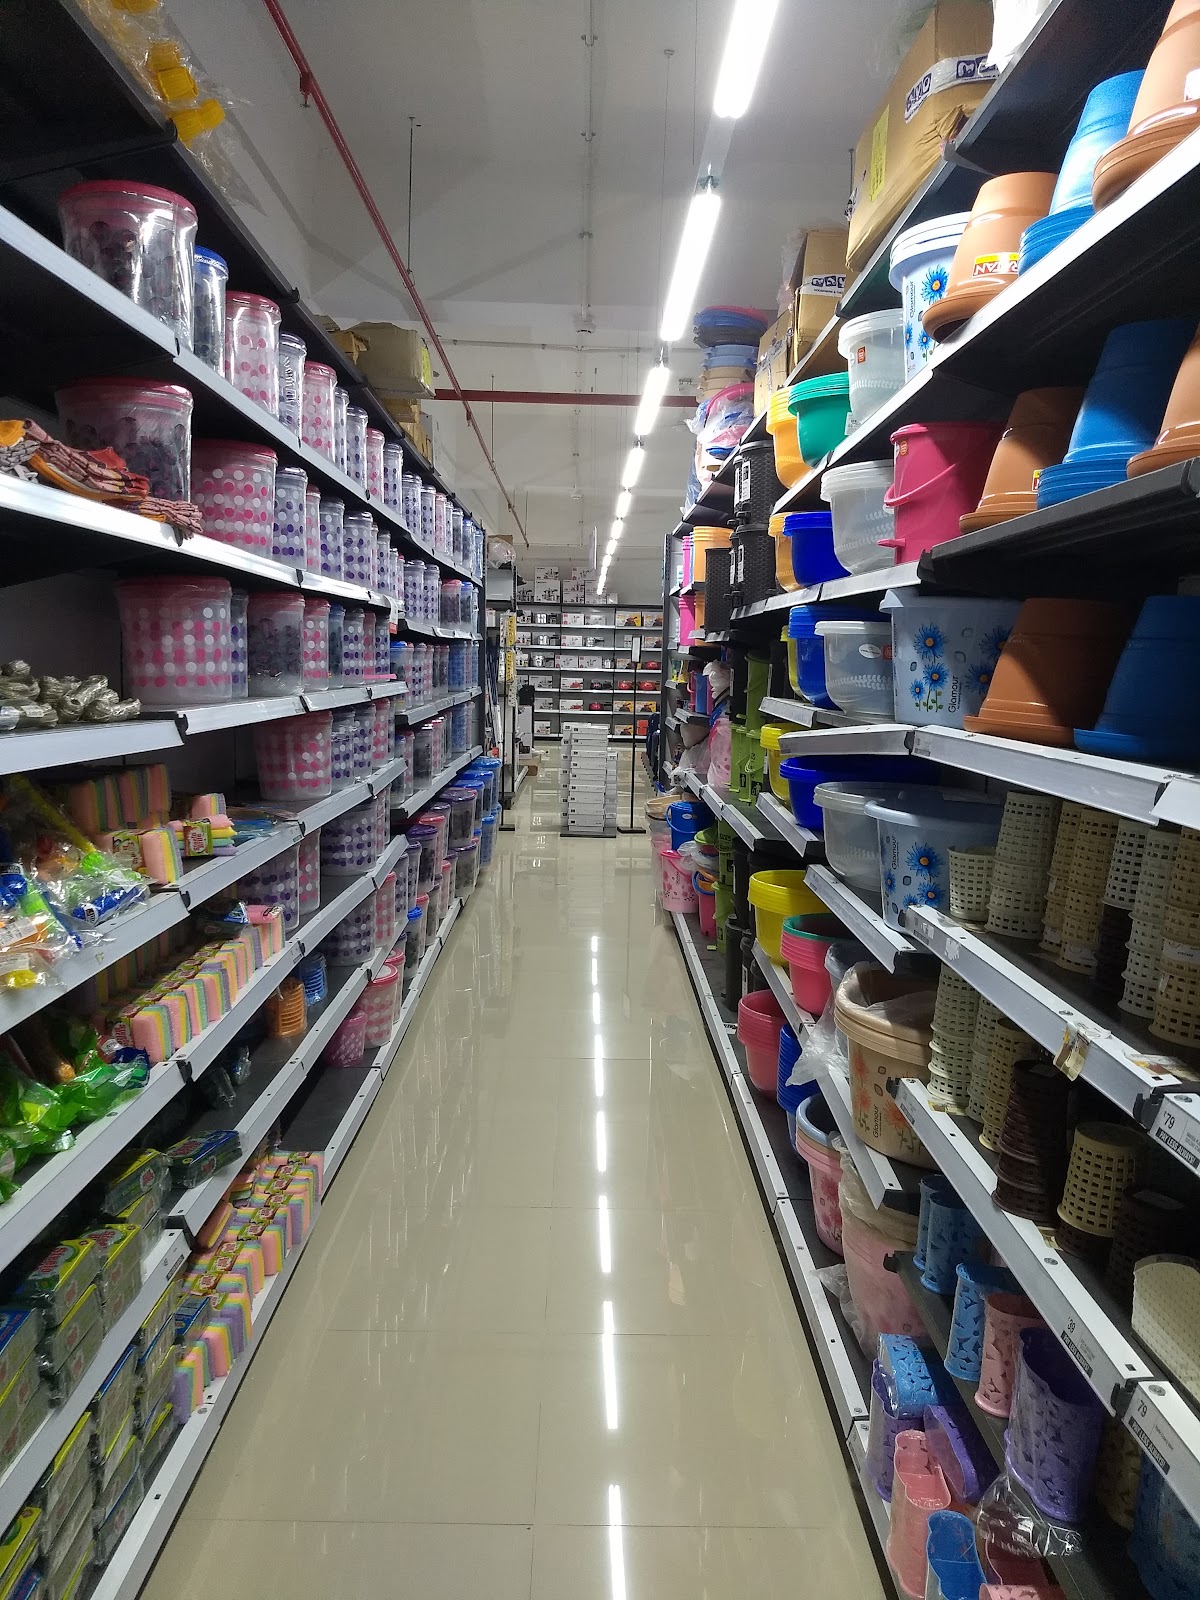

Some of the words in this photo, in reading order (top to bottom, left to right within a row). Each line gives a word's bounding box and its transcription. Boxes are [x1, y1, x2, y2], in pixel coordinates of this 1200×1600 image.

[948, 675, 959, 713] Glamour
[1166, 1136, 1179, 1151] LESS
[1140, 1431, 1150, 1447] LESS
